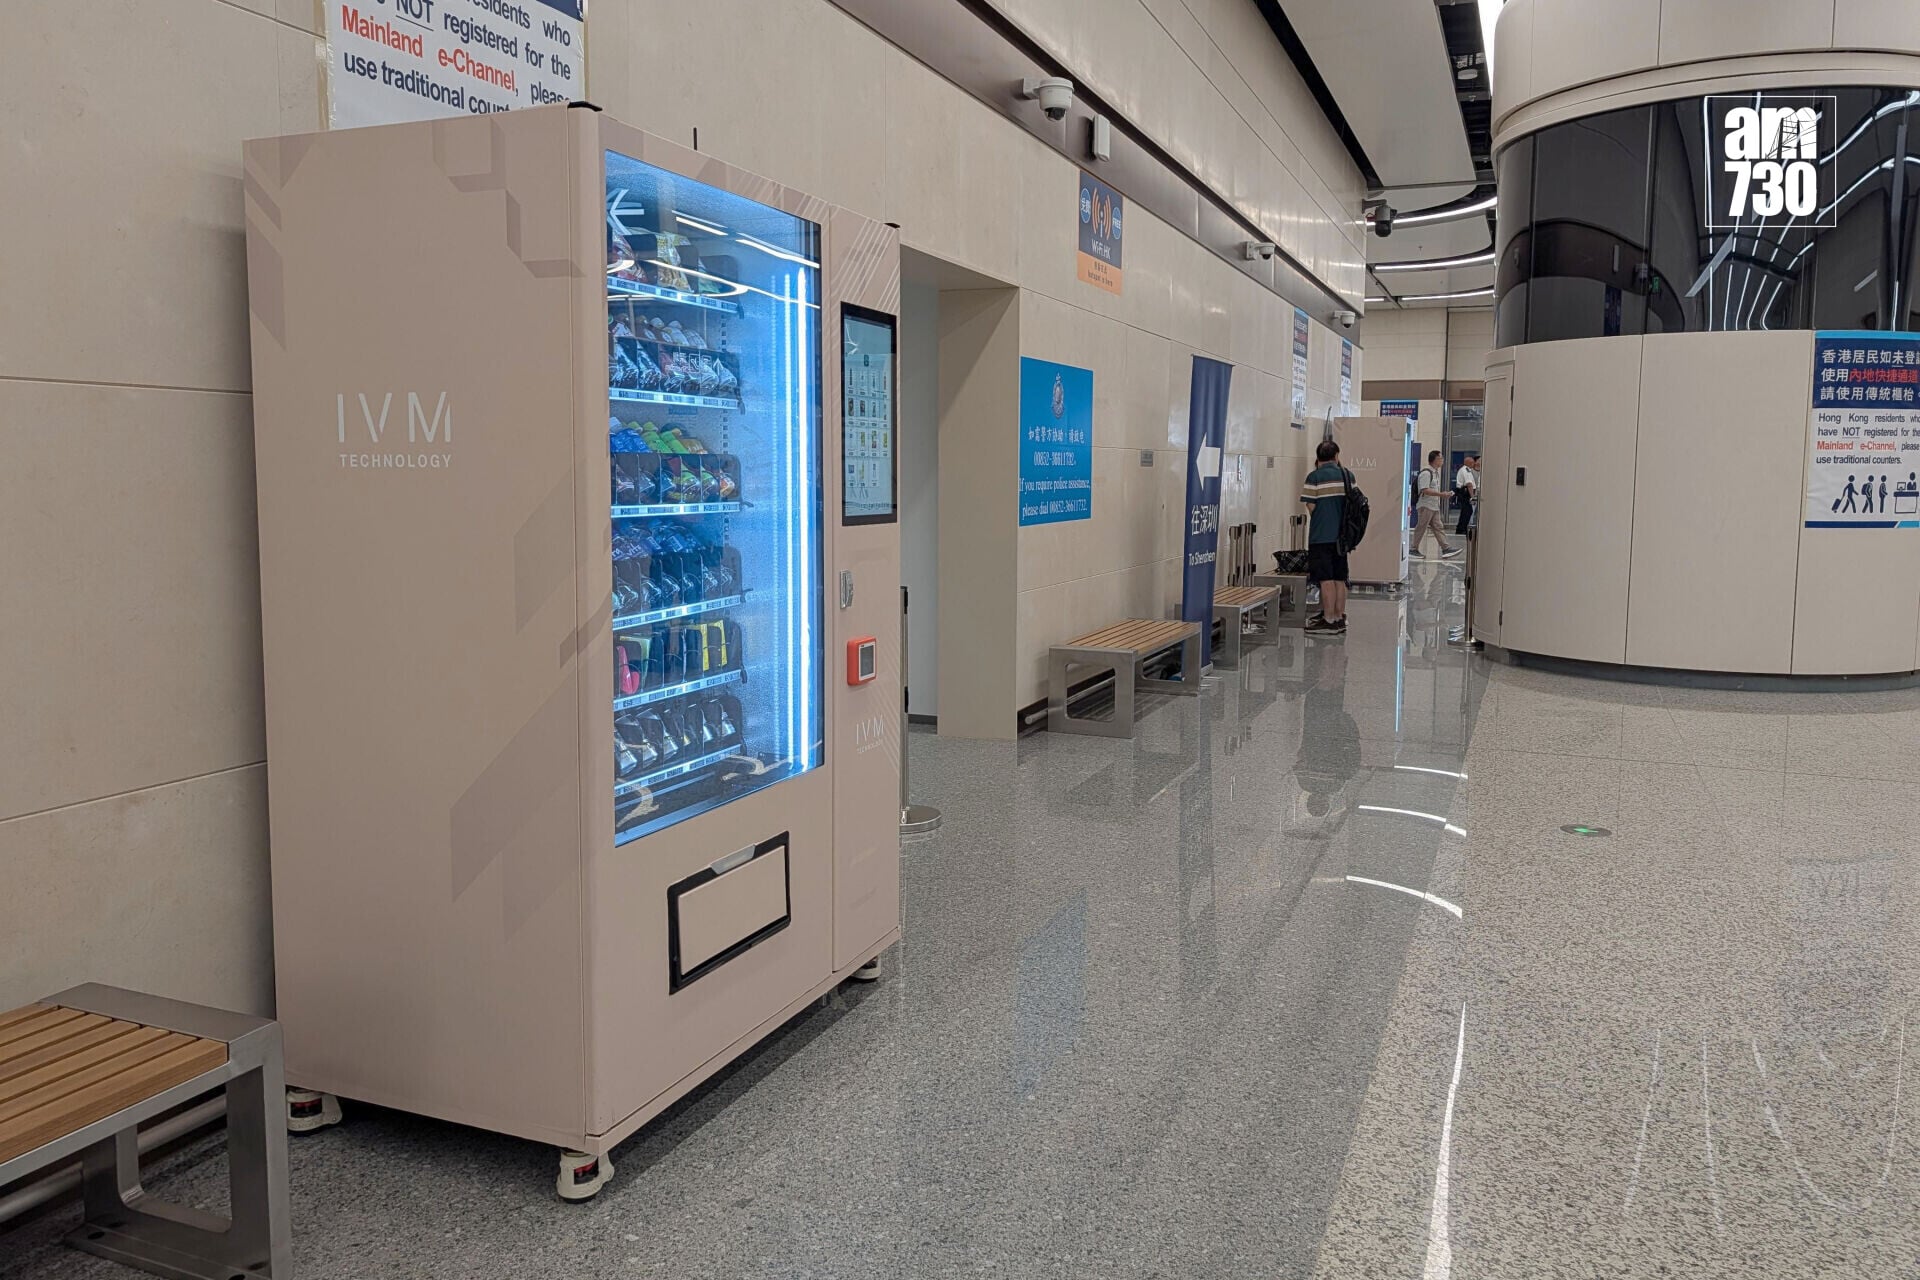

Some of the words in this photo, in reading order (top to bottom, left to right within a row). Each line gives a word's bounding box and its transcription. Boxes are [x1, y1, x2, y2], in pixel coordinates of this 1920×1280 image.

[464, 0, 531, 29] sidents
[542, 19, 570, 46] who
[342, 5, 423, 58] Mainland
[438, 48, 519, 97] e-Channel,
[530, 82, 570, 105] pleas
[443, 11, 518, 58] registered
[525, 42, 544, 68] for
[551, 52, 571, 80] the
[344, 52, 378, 80] use
[382, 61, 465, 110] traditional
[337, 391, 451, 443] IVM
[1818, 413, 1842, 424] Hong
[1848, 413, 1869, 424] Kong
[1874, 413, 1906, 423] residents
[1817, 427, 1838, 436] have
[1842, 427, 1861, 437] NOT
[1863, 427, 1898, 438] registered
[1901, 427, 1910, 437] for
[1912, 428, 1920, 437] the
[1816, 441, 1853, 451] Mainland
[1860, 441, 1897, 452] e-Channel,
[1901, 442, 1919, 452] please
[339, 454, 452, 468] TECHNOLOGY
[1816, 455, 1831, 464] use
[1833, 455, 1871, 465] traditional
[1872, 455, 1902, 465] counters.
[1019, 477, 1025, 492] If
[1025, 481, 1034, 495] you
[1036, 477, 1052, 494] require
[1054, 477, 1067, 493] police
[1022, 503, 1038, 521] please
[1039, 500, 1049, 515] dial
[1191, 504, 1218, 536] 往深圳
[1189, 553, 1195, 567] To
[1195, 550, 1216, 566] Shenzhen
[856, 713, 884, 745] IVM
